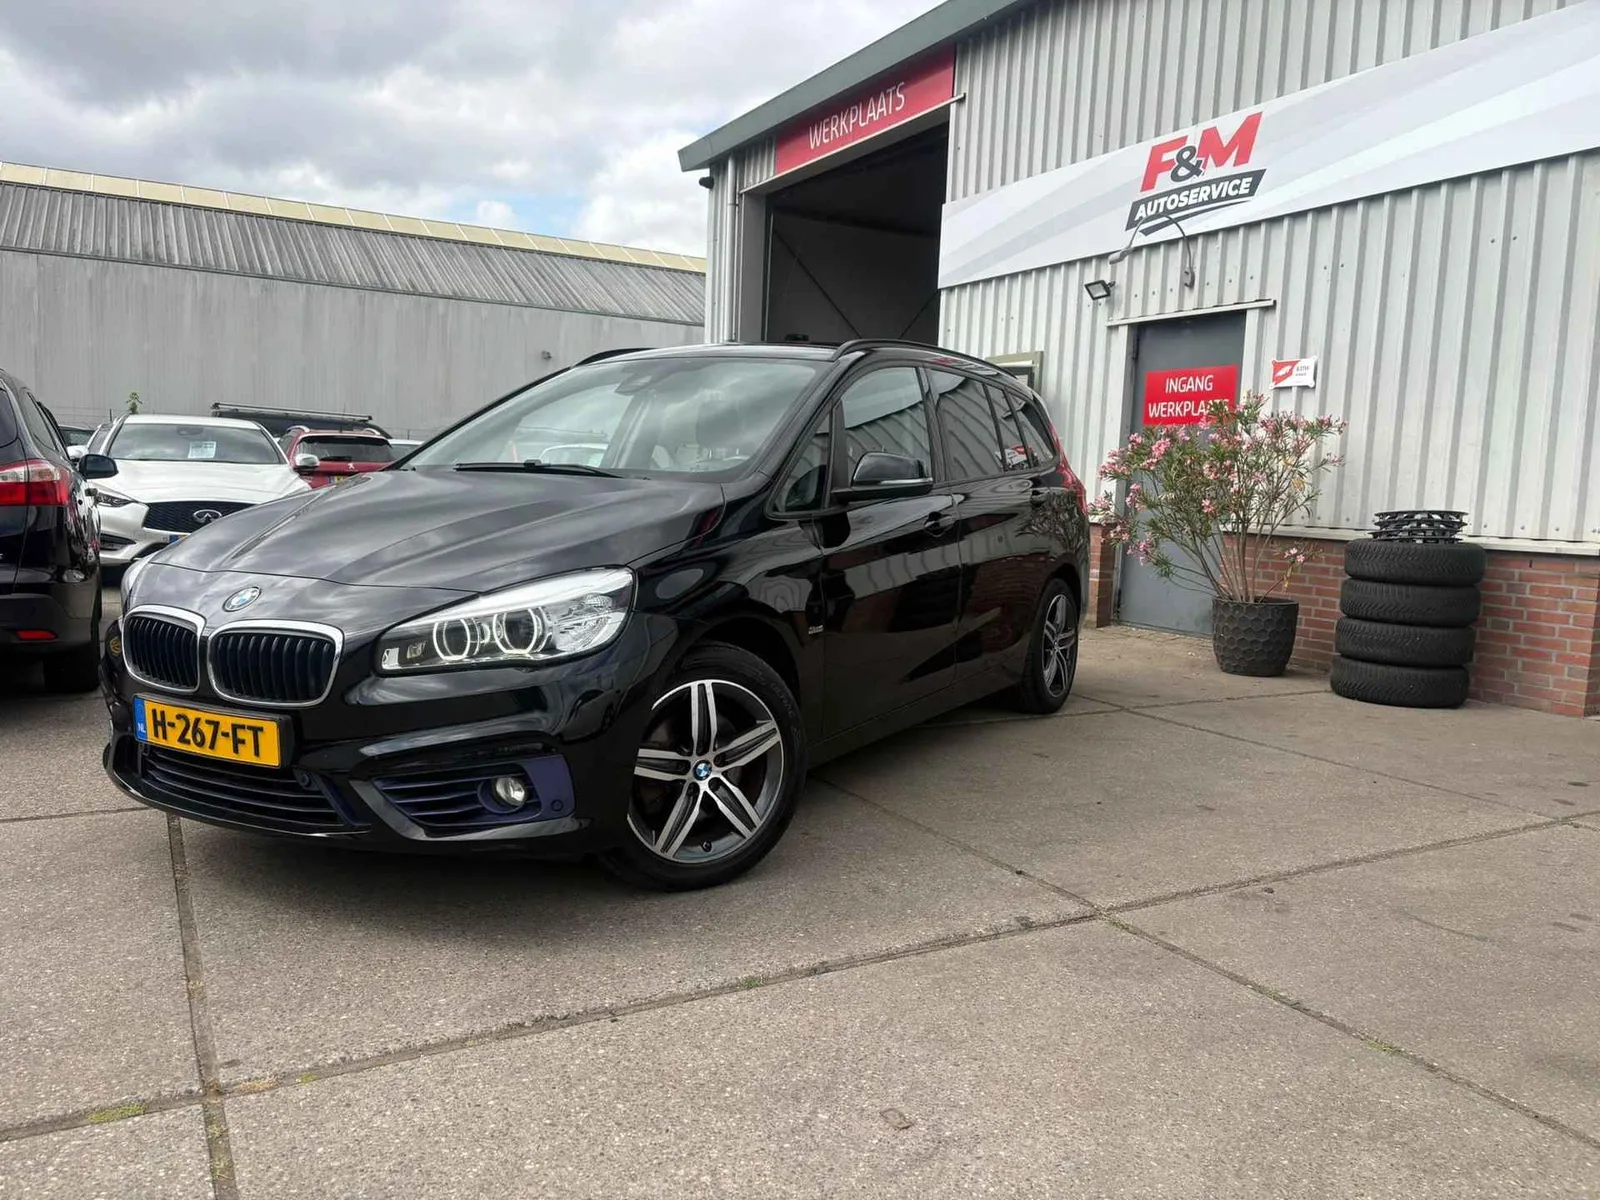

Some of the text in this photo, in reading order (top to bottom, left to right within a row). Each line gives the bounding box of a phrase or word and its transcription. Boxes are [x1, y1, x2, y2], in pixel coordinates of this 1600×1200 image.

[809, 81, 906, 150] WERKPLAATS
[1140, 111, 1263, 193] F&M
[1134, 177, 1253, 222] AUTOSERVICE
[1165, 374, 1214, 393] INGANG
[137, 722, 147, 734] NL
[151, 708, 264, 758] H-267-FT
